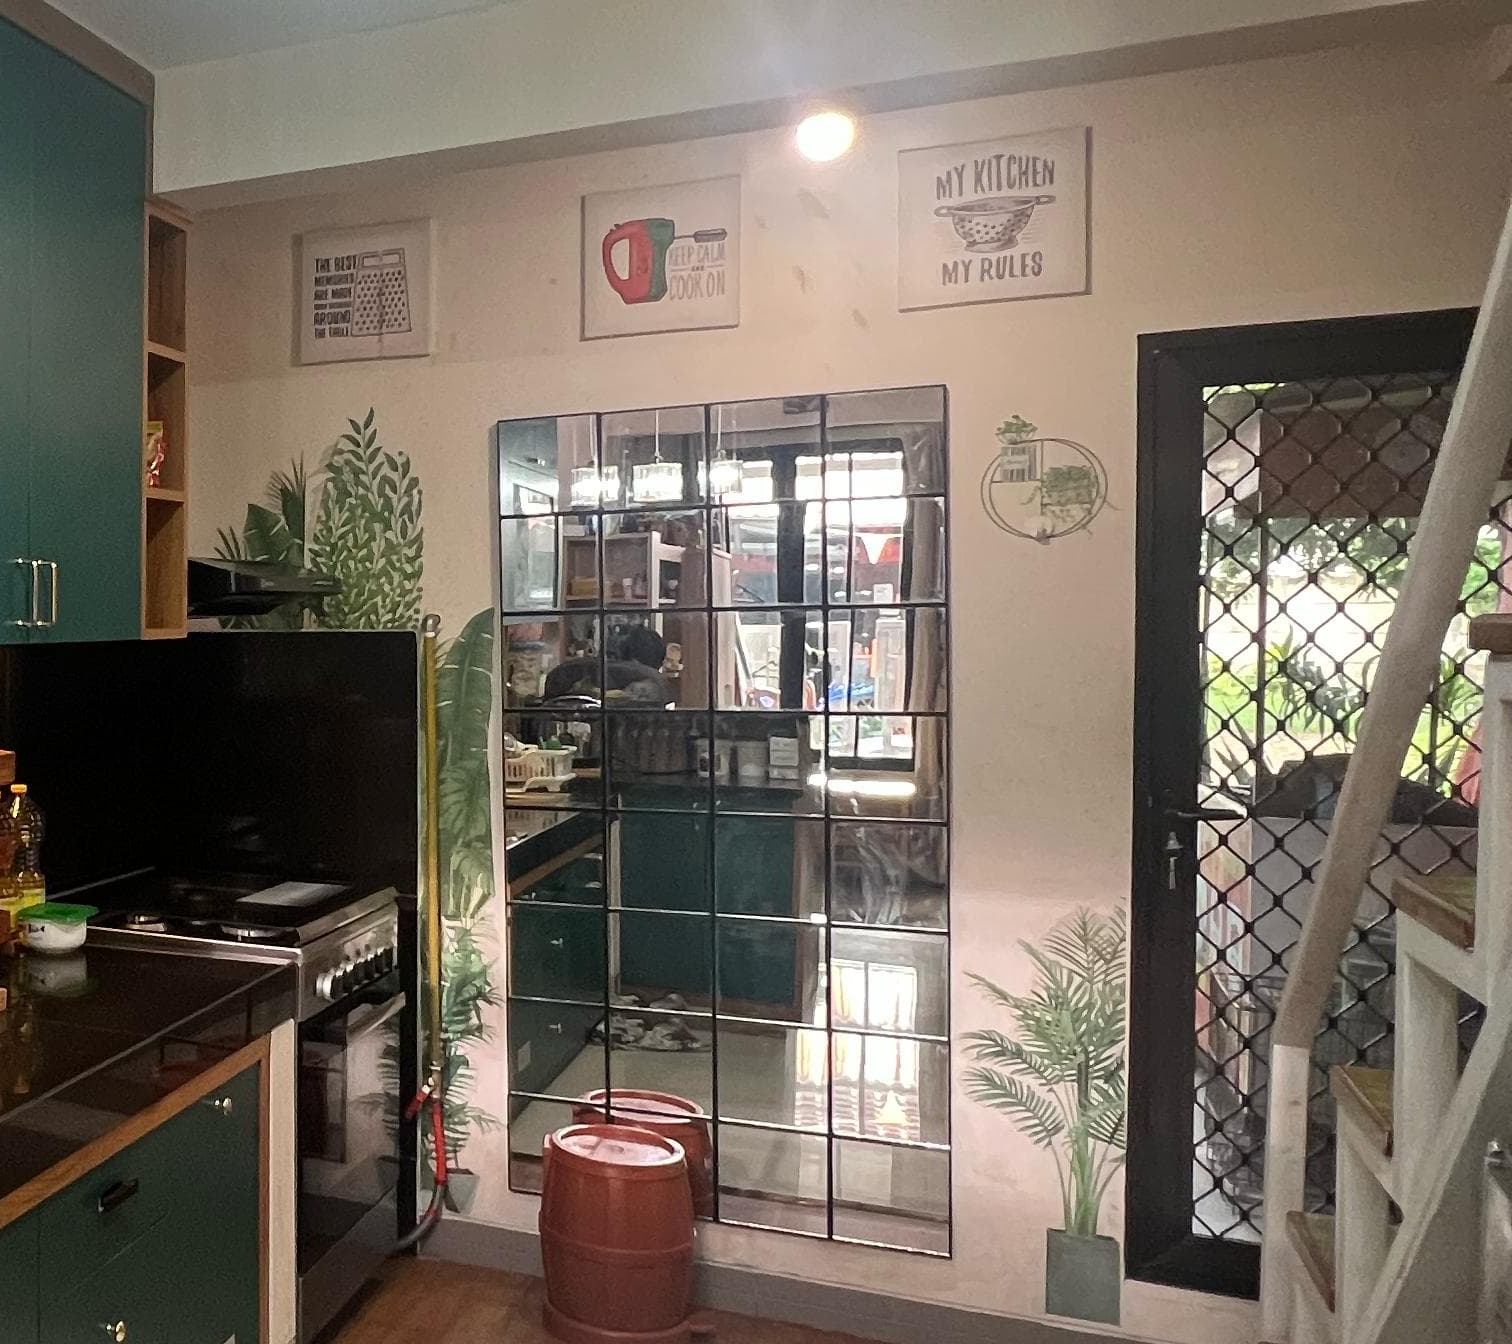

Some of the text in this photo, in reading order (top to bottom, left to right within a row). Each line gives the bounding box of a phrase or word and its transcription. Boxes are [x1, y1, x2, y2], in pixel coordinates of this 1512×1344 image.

[935, 153, 1056, 201] MY KITCHEN
[335, 255, 357, 271] BEST
[941, 250, 1044, 287] MY RULES
[669, 269, 726, 301] COOK ON
